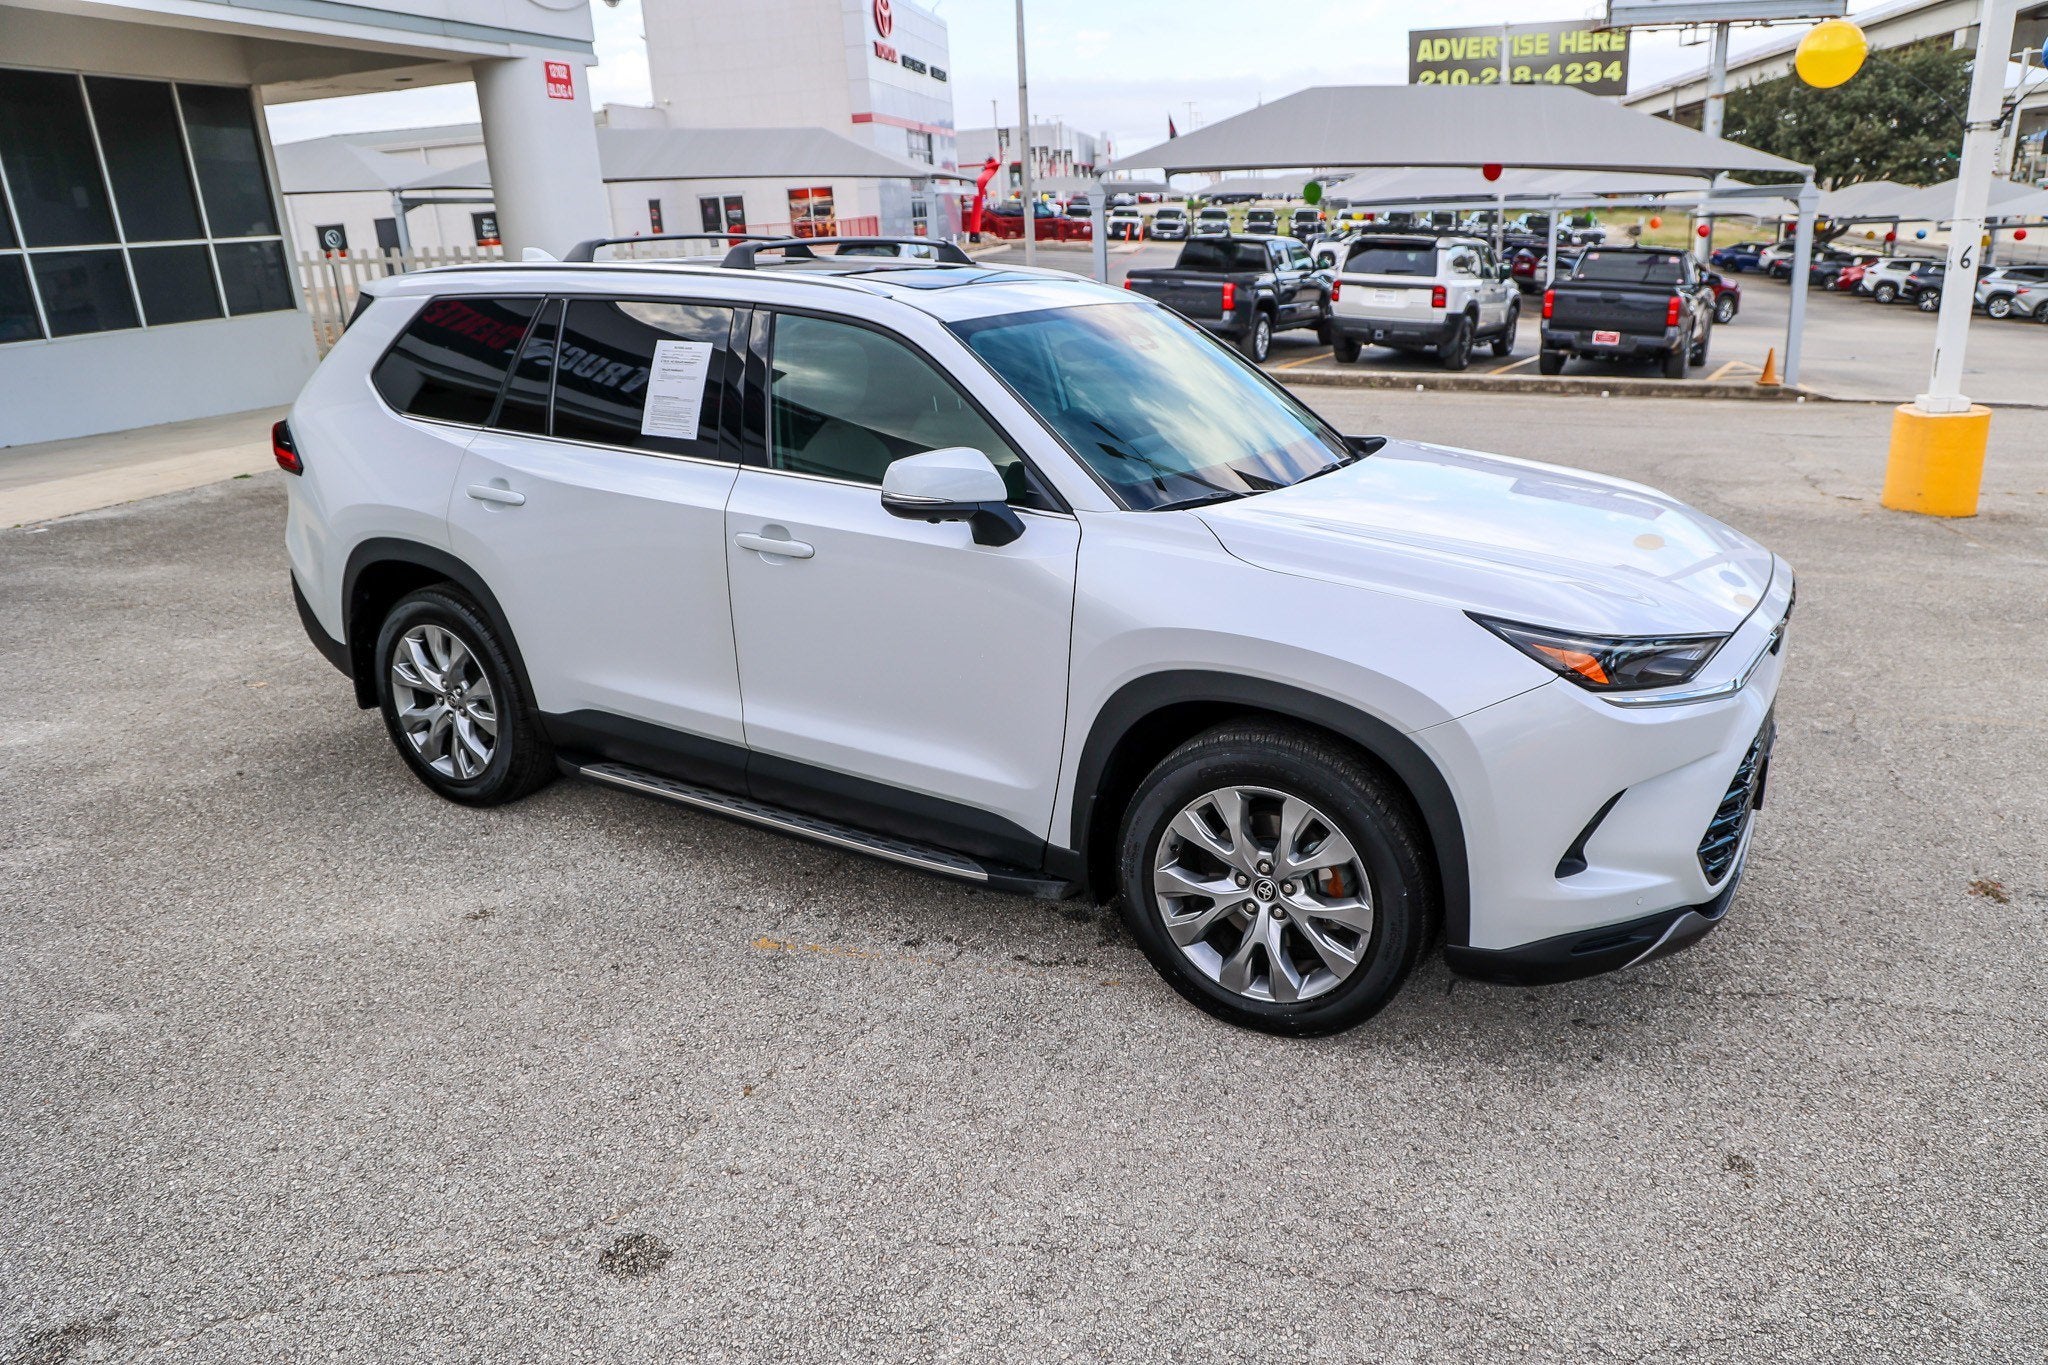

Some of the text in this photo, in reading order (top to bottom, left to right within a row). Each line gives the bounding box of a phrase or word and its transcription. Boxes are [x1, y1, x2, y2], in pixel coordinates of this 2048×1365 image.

[1559, 29, 1626, 54] HERE
[1418, 60, 1623, 86] 210-28-4234
[1960, 245, 1972, 268] 6
